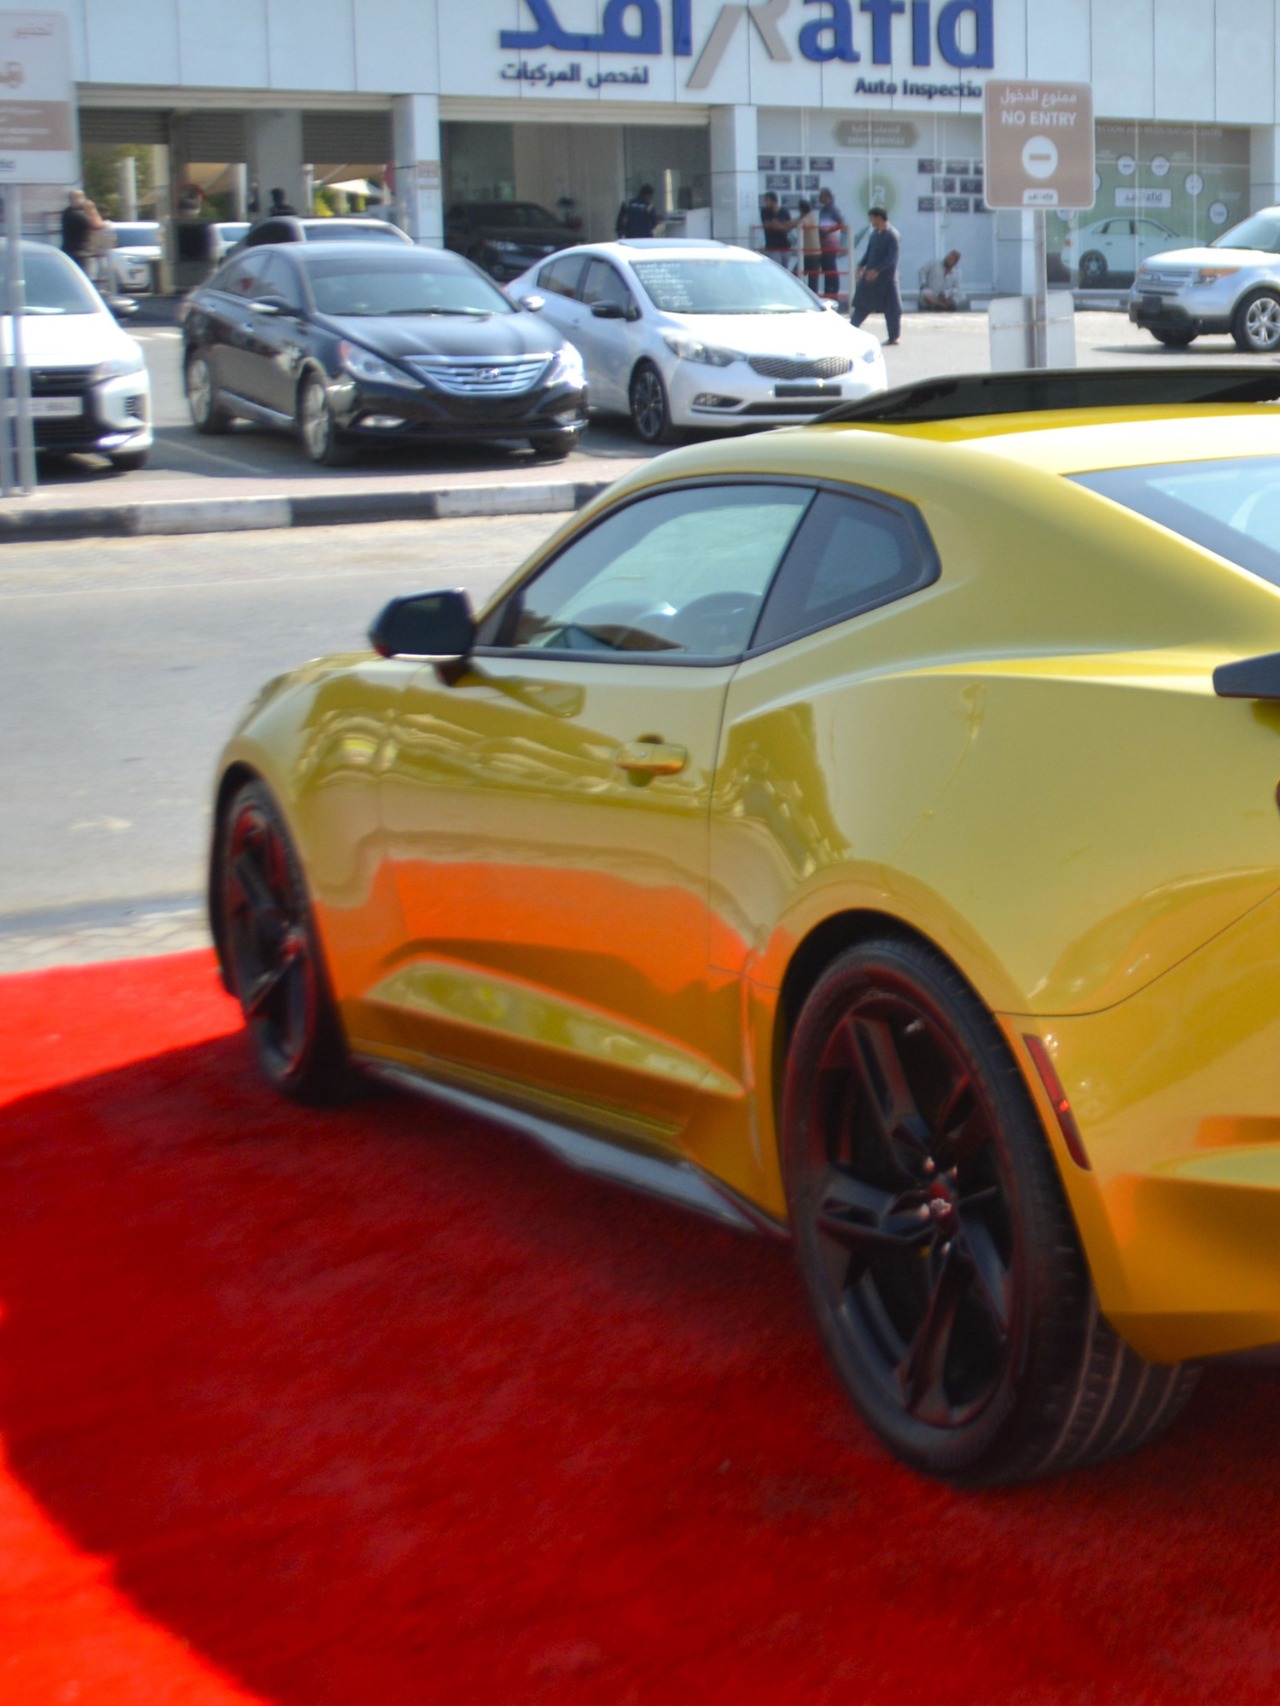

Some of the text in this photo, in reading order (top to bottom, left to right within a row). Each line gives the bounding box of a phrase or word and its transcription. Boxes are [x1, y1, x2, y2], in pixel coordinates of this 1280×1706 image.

[501, 61, 649, 89] لفحص المركبات
[855, 77, 983, 99] Auto Inspectio
[1001, 87, 1077, 108] ممنوع الدخول
[1001, 110, 1077, 126] NO ENTRY
